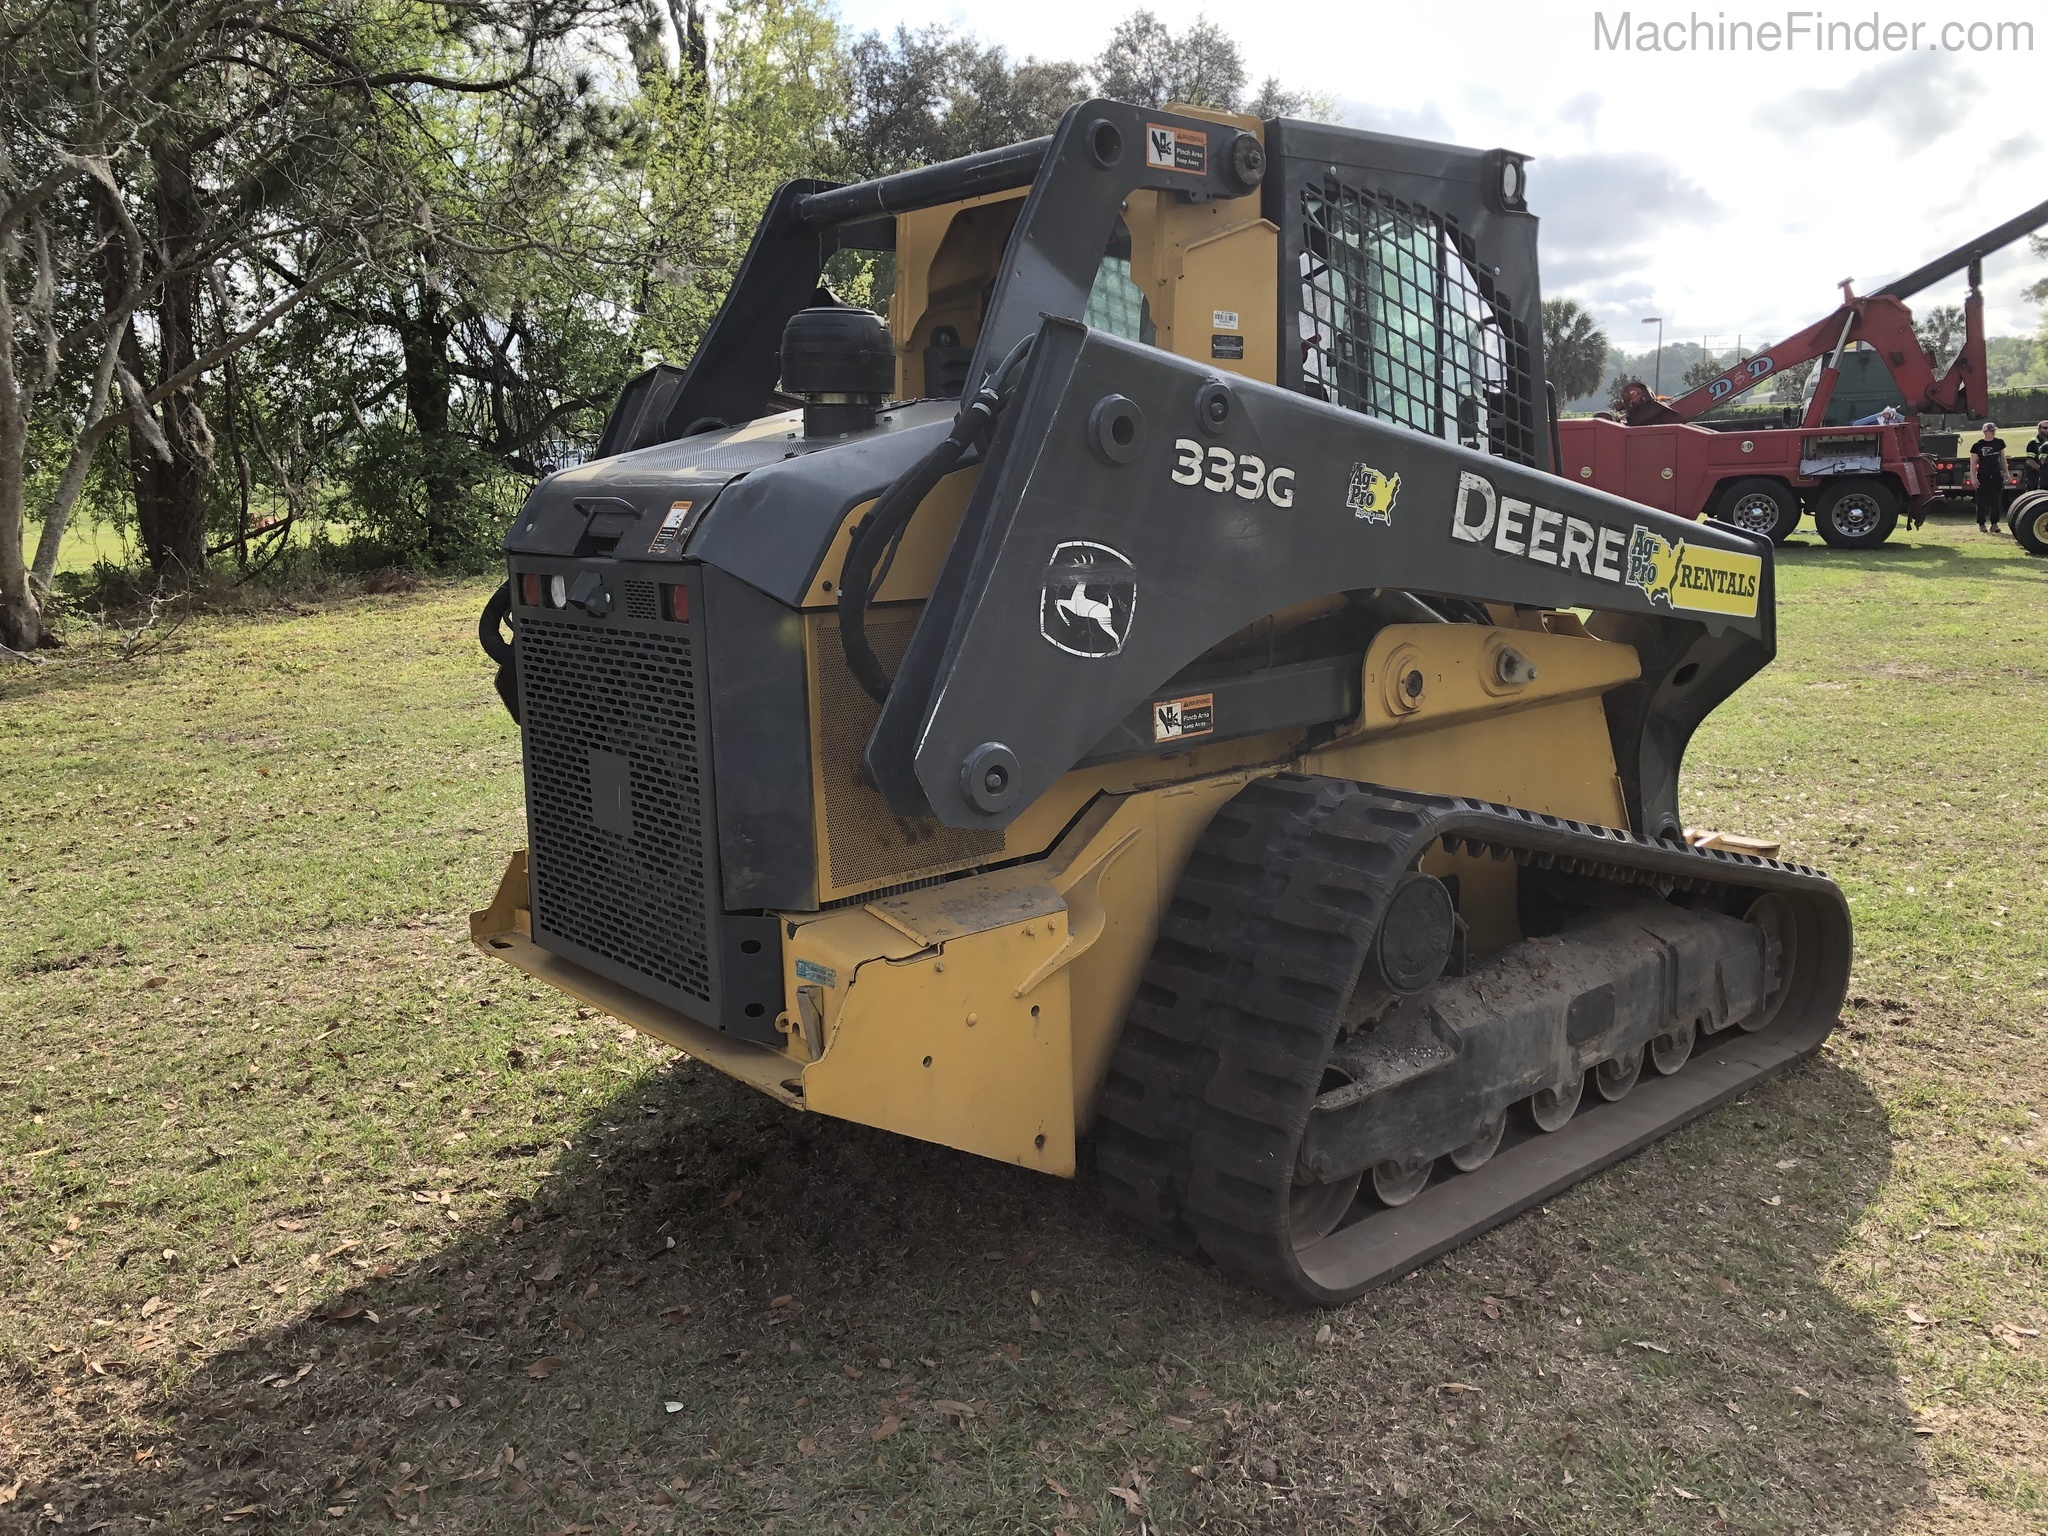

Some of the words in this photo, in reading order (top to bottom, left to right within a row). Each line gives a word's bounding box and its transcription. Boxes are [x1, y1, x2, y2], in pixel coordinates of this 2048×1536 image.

[1176, 147, 1191, 156] Pinch
[1191, 150, 1203, 158] Area
[1182, 134, 1204, 143] WARNING
[1708, 378, 1733, 401] D
[1746, 356, 1775, 380] D
[1171, 438, 1296, 508] 333G
[1352, 464, 1377, 490] Ag-
[1349, 485, 1375, 507] Pro
[1451, 470, 1626, 583] DEERE
[1632, 530, 1659, 562] Ag-
[1628, 559, 1658, 586] Pro
[1679, 563, 1757, 598] RENTALS
